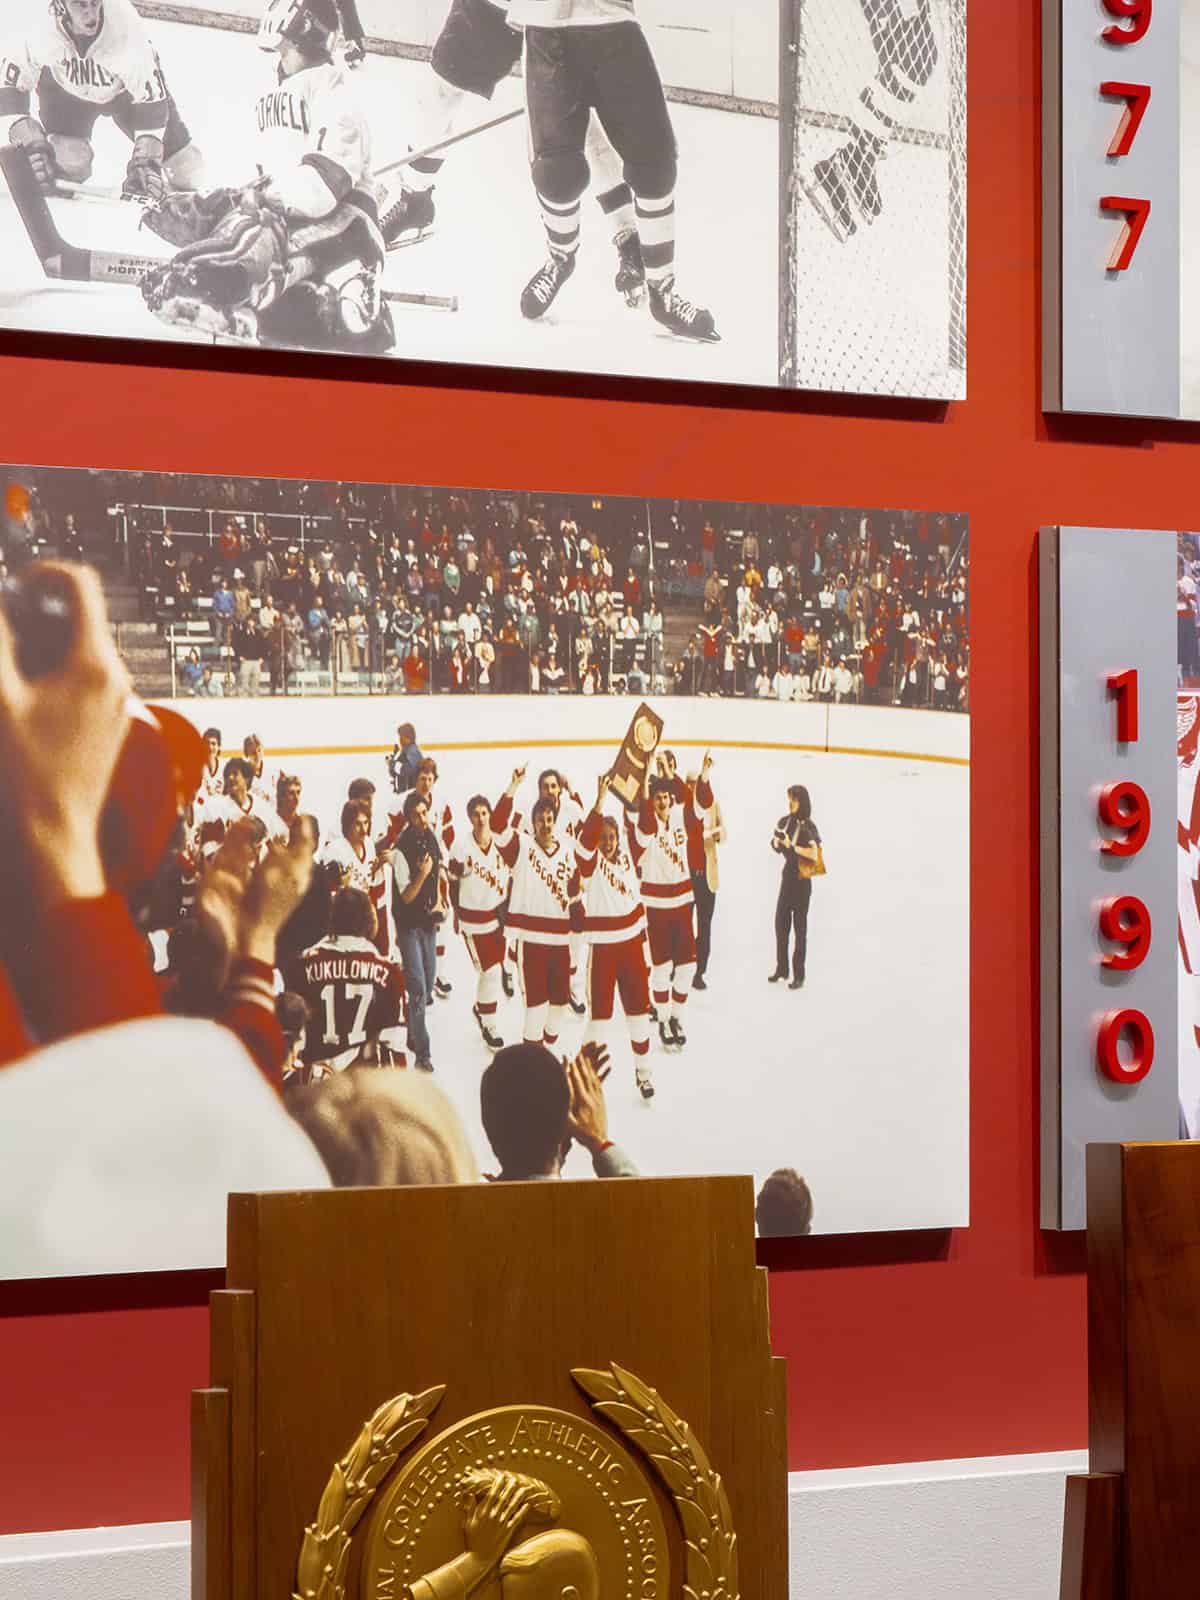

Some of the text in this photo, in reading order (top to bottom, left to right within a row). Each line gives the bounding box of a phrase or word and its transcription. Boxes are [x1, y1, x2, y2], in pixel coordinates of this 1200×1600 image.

[1097, 668, 1155, 1085] 1990
[305, 959, 390, 988] KUKULOWICZ
[320, 983, 374, 1046] 17
[383, 1425, 498, 1546] COLLEGIATE
[508, 1415, 626, 1487] ATHLETIC
